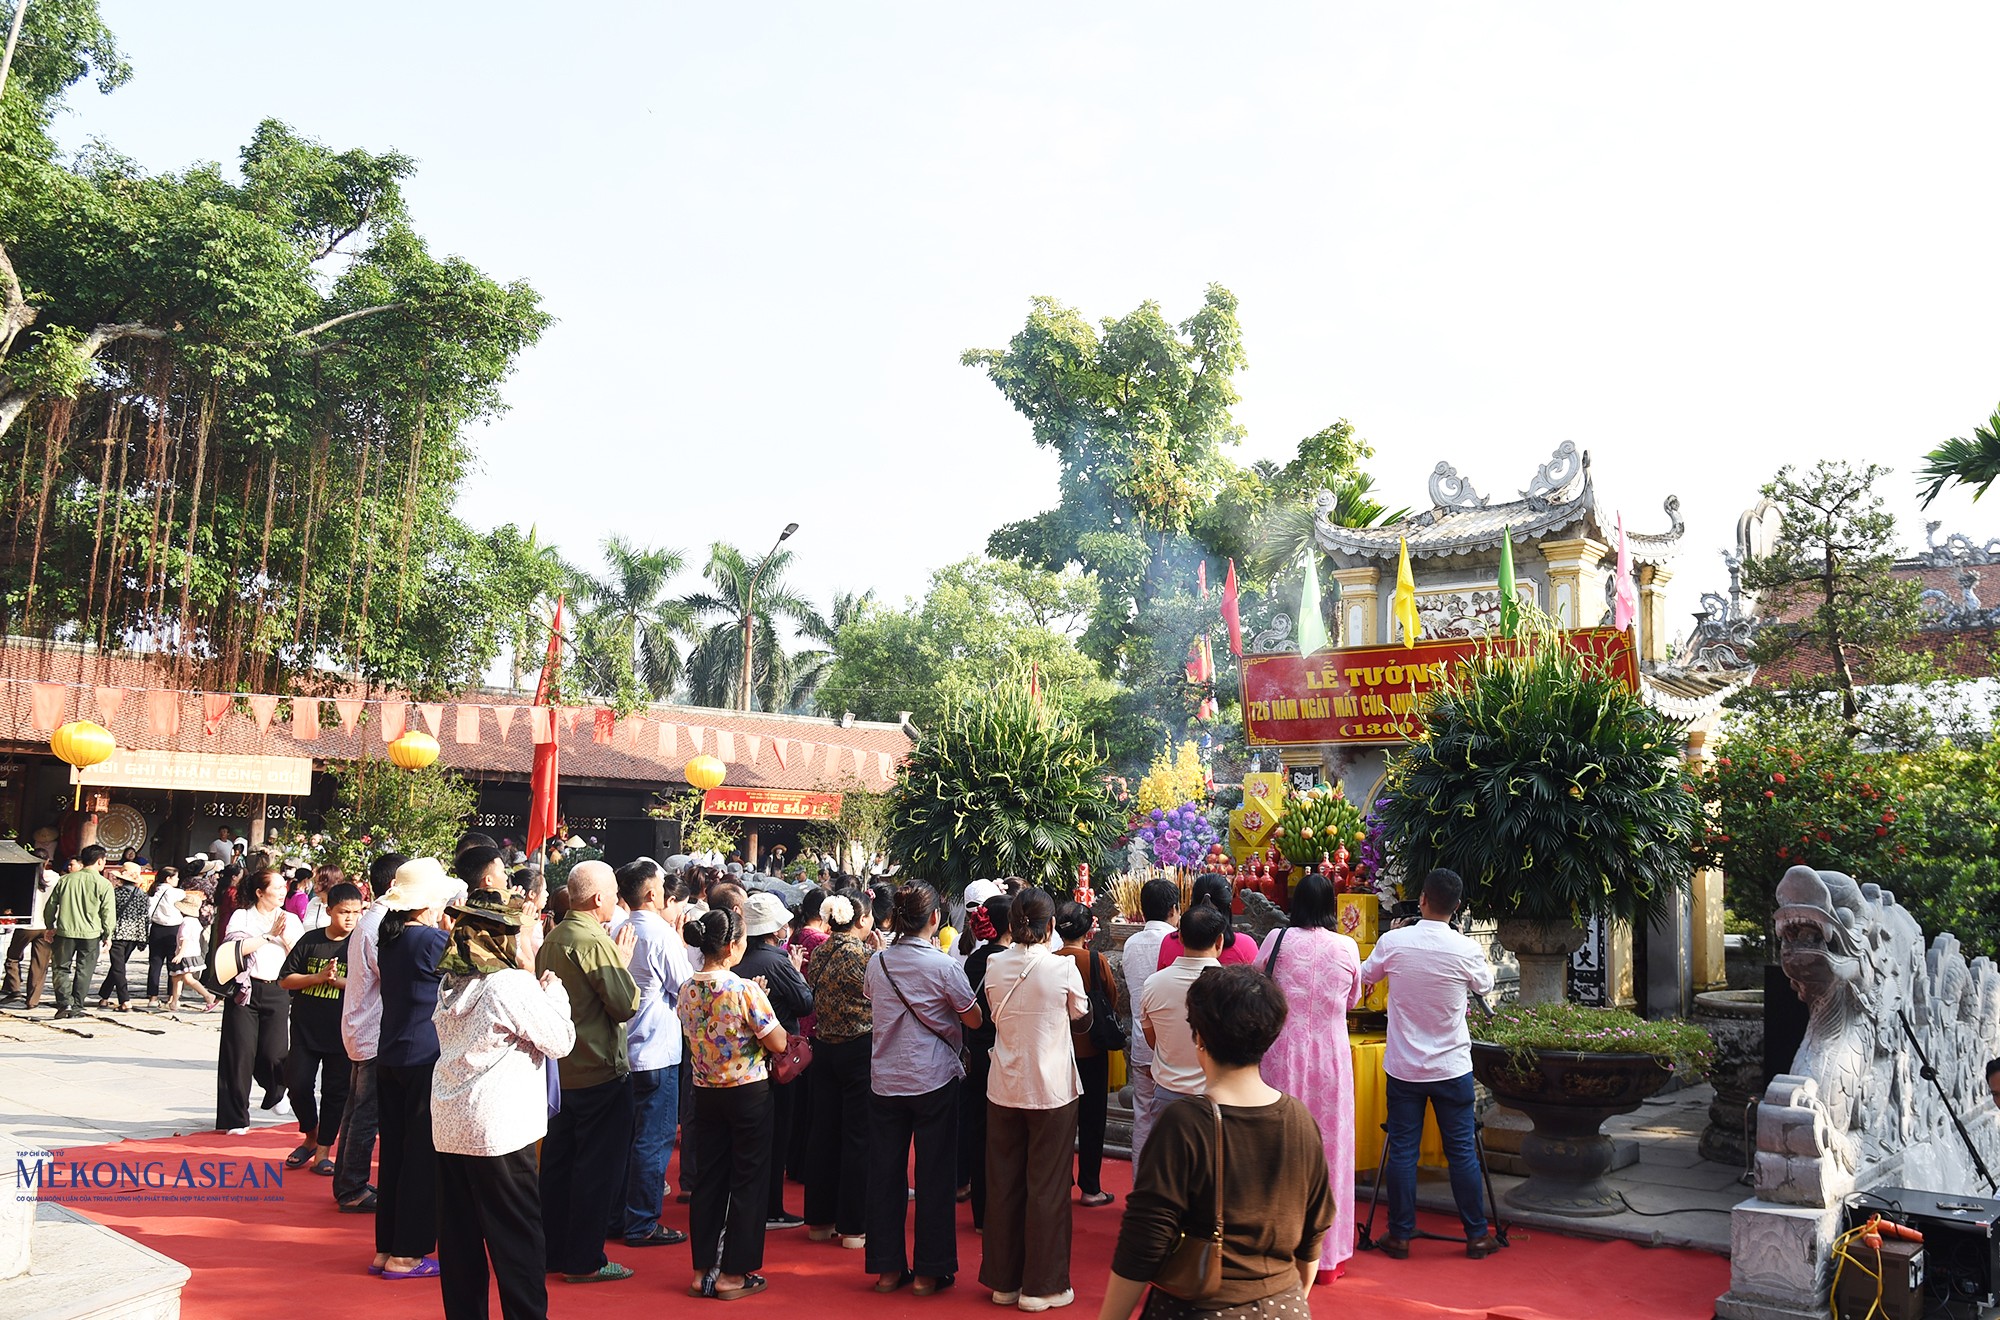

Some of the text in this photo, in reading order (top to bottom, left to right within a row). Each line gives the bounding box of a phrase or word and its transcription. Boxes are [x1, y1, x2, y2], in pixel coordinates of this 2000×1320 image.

[1305, 661, 1340, 690] LỄ
[1344, 659, 1449, 688] TƯỞNG
[1250, 701, 1270, 722] 726
[1272, 695, 1299, 721] NĂM
[1300, 693, 1330, 720] NGÀY
[1334, 690, 1359, 719] MẤT
[1361, 688, 1387, 717] CỦA
[124, 763, 156, 776] GHI
[161, 764, 211, 779] NHẬN
[216, 766, 262, 780] CÔNG
[717, 800, 748, 812] KHU
[752, 801, 779, 815] VỰC
[783, 800, 810, 815] SẮP
